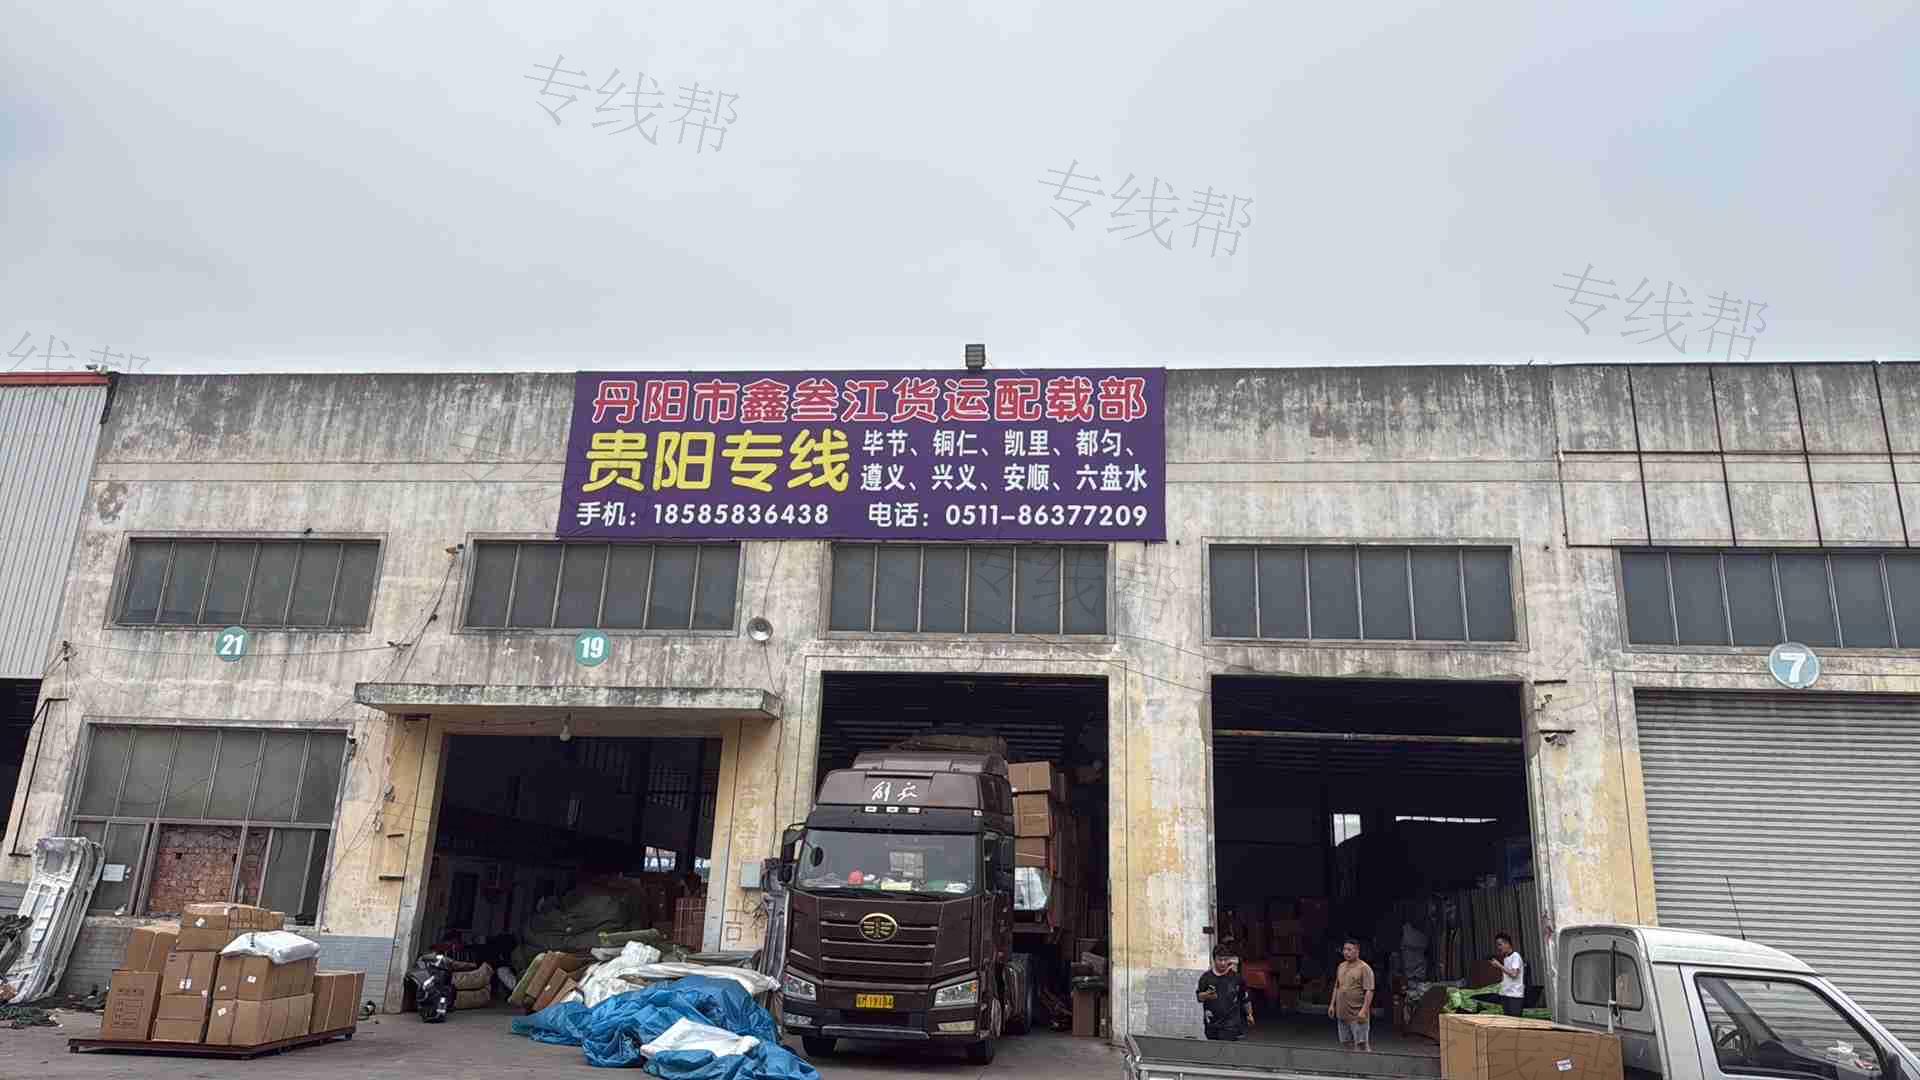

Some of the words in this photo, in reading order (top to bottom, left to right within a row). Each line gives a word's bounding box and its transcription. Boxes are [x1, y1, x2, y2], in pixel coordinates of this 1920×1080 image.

[592, 376, 1147, 423] 丹阳市鑫叁江货运配载部
[581, 429, 850, 493] 贵阳专线
[220, 634, 244, 655] 21
[581, 636, 605, 658] 19
[1778, 651, 1807, 684] 7
